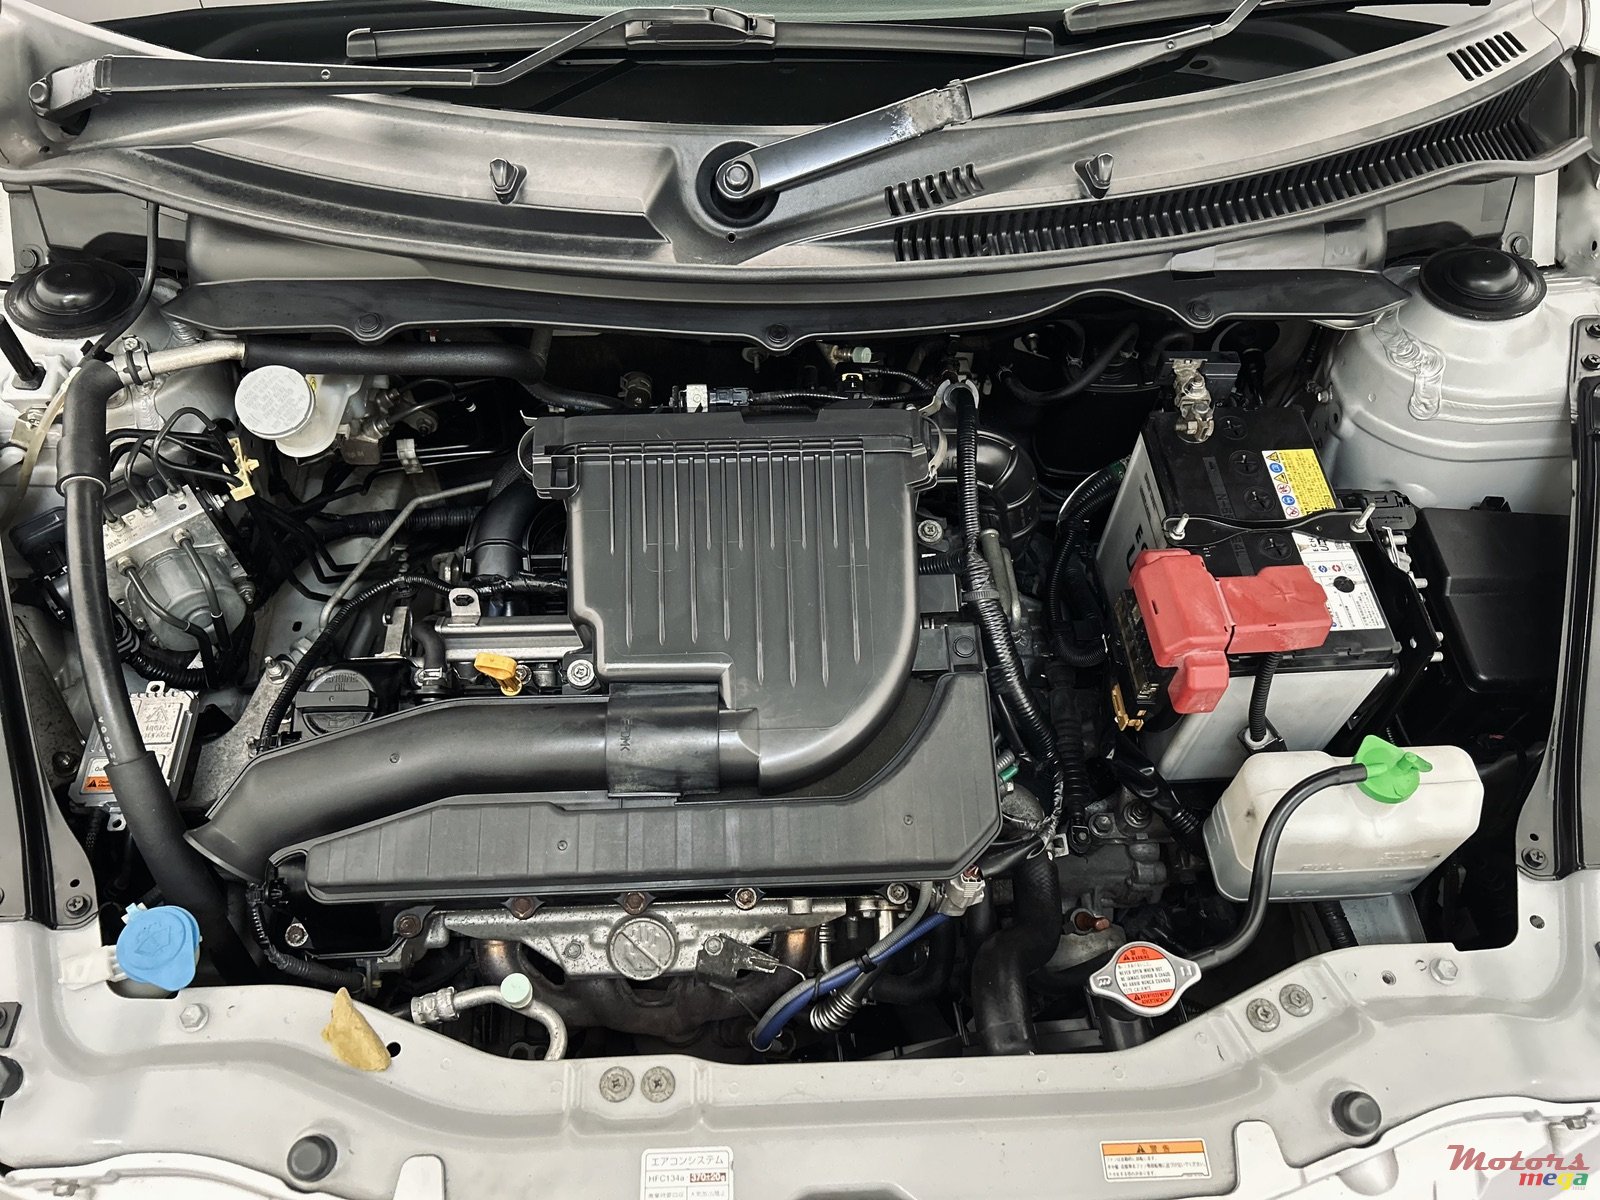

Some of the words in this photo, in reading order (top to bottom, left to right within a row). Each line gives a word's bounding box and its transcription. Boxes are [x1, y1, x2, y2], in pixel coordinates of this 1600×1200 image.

[651, 1155, 723, 1166] エアコンシステム
[648, 1175, 685, 1183] HFC134a
